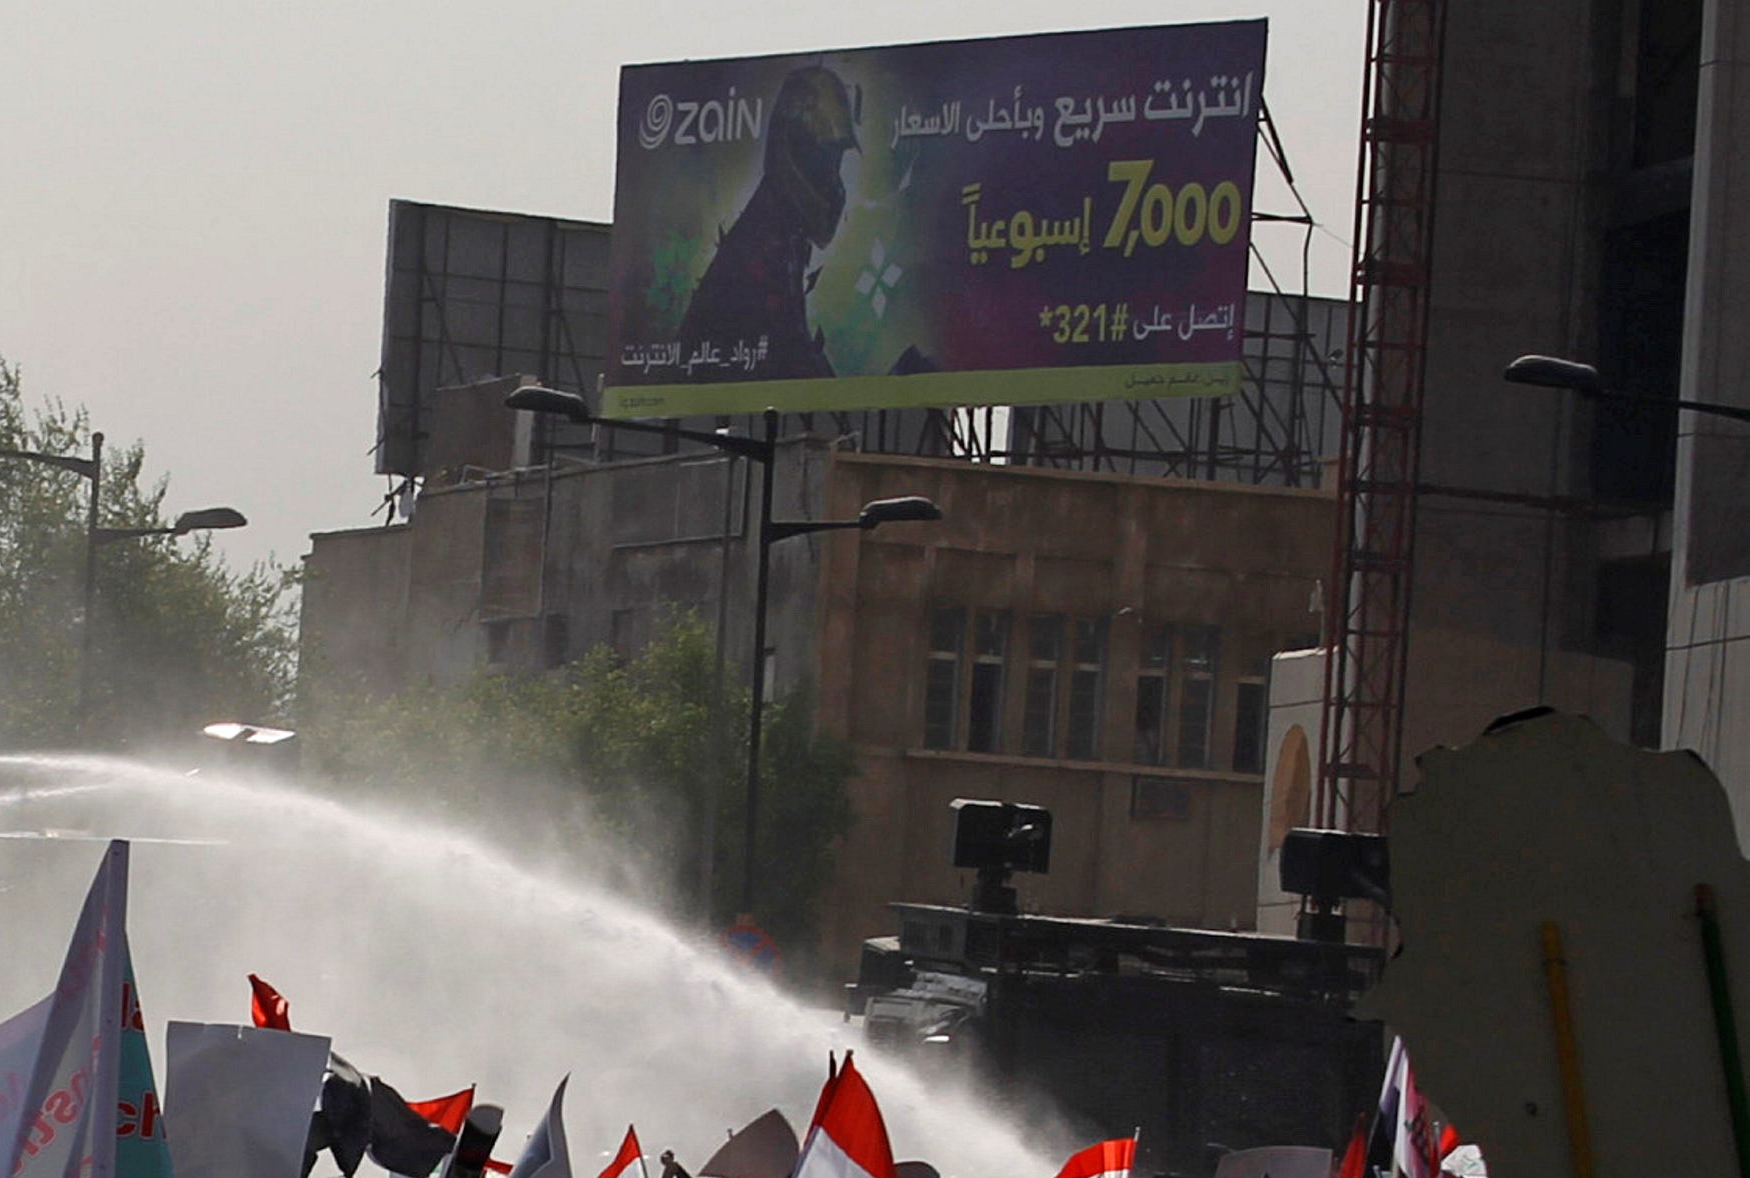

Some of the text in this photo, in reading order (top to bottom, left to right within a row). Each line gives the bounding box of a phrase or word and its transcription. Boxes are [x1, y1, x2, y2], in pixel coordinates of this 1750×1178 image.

[966, 84, 1045, 142] وبأحلى
[1054, 94, 1136, 147] سريع
[1144, 70, 1254, 138] انترنت
[1133, 305, 1172, 341] على
